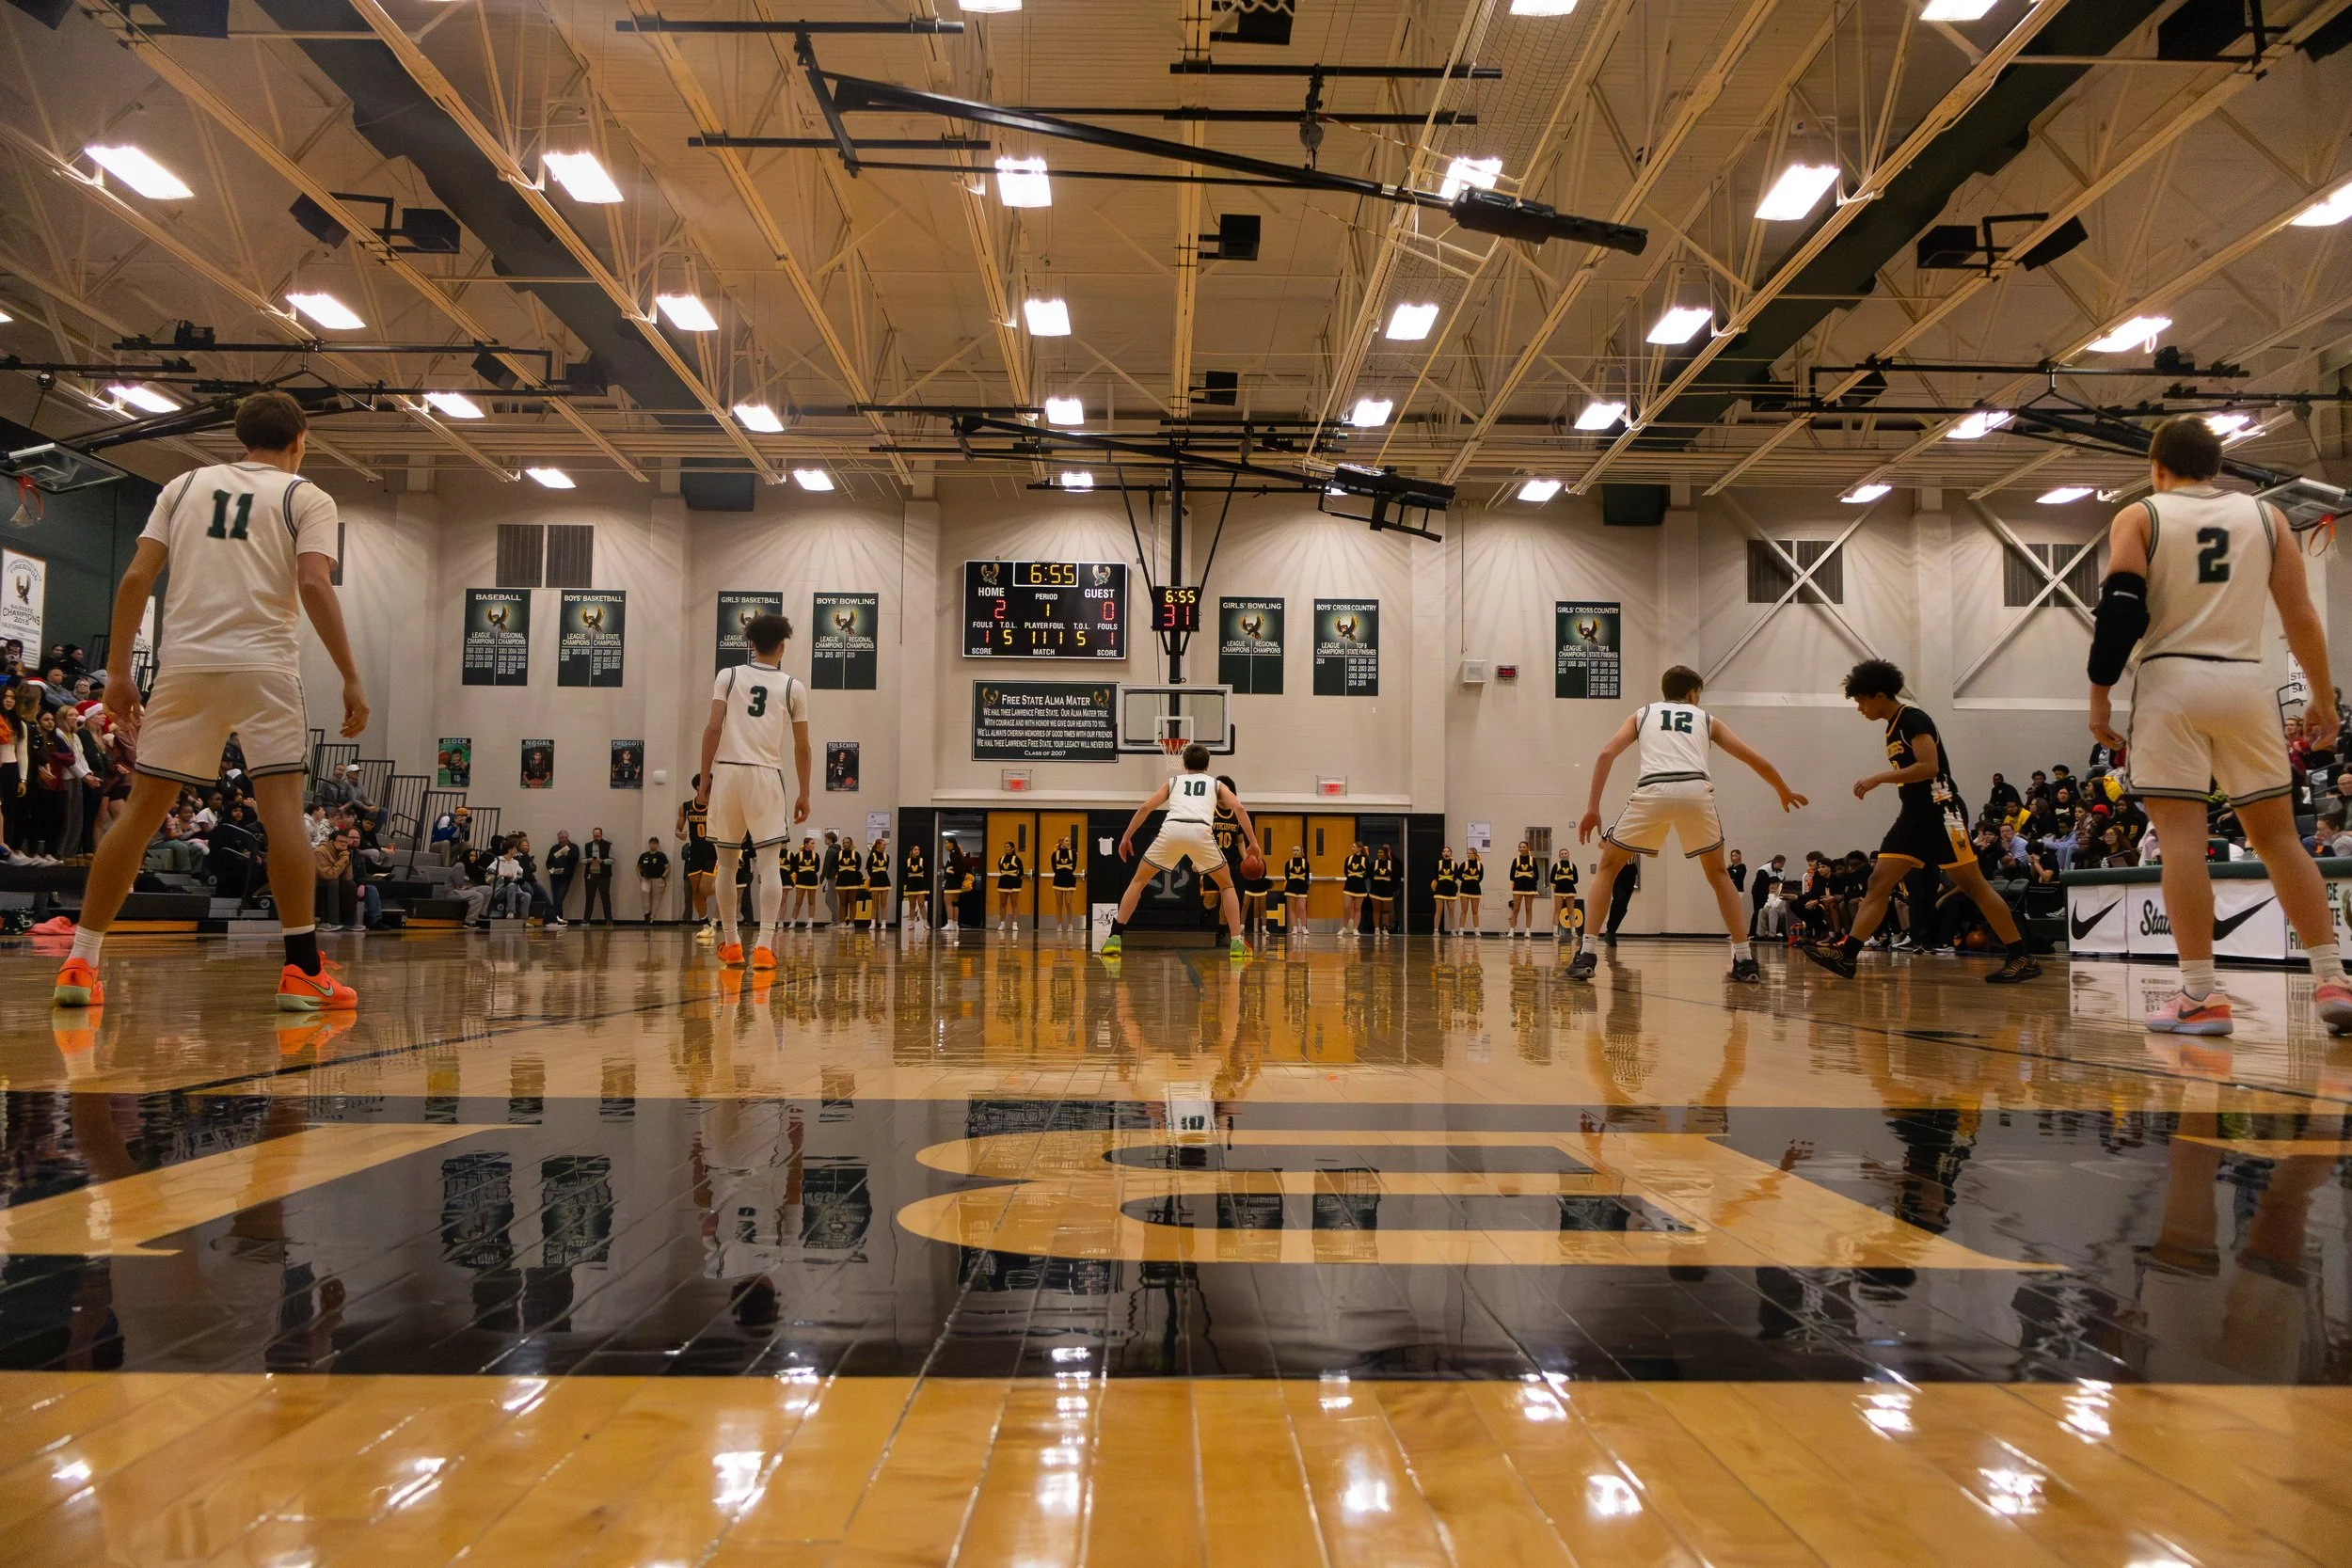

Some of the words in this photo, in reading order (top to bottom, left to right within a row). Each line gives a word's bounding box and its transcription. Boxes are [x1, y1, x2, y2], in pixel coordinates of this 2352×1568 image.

[207, 489, 254, 540] 11
[2197, 527, 2230, 583] 2
[1030, 564, 1074, 583] 6:55
[978, 587, 1005, 597] HOME
[1084, 588, 1115, 599] GUEST
[1166, 590, 1195, 603] 6:55
[3, 607, 40, 626] CHAMPIONS
[994, 600, 1006, 618] 2
[1046, 603, 1050, 617] 1
[1103, 602, 1114, 620] 0
[1164, 604, 1190, 626] 31
[985, 630, 989, 643] 1
[1003, 630, 1012, 645] 5
[1076, 631, 1086, 646] 5
[1111, 632, 1114, 645] 1
[748, 686, 768, 717] 3
[1002, 695, 1021, 705] FREE
[1022, 695, 1043, 705] STATE
[1044, 695, 1065, 705] ALMA
[1066, 695, 1090, 706] MATER
[1661, 710, 1693, 734] 12
[1184, 781, 1206, 796] 10
[1213, 822, 1237, 832] VIKINGS
[1217, 832, 1232, 848] 10
